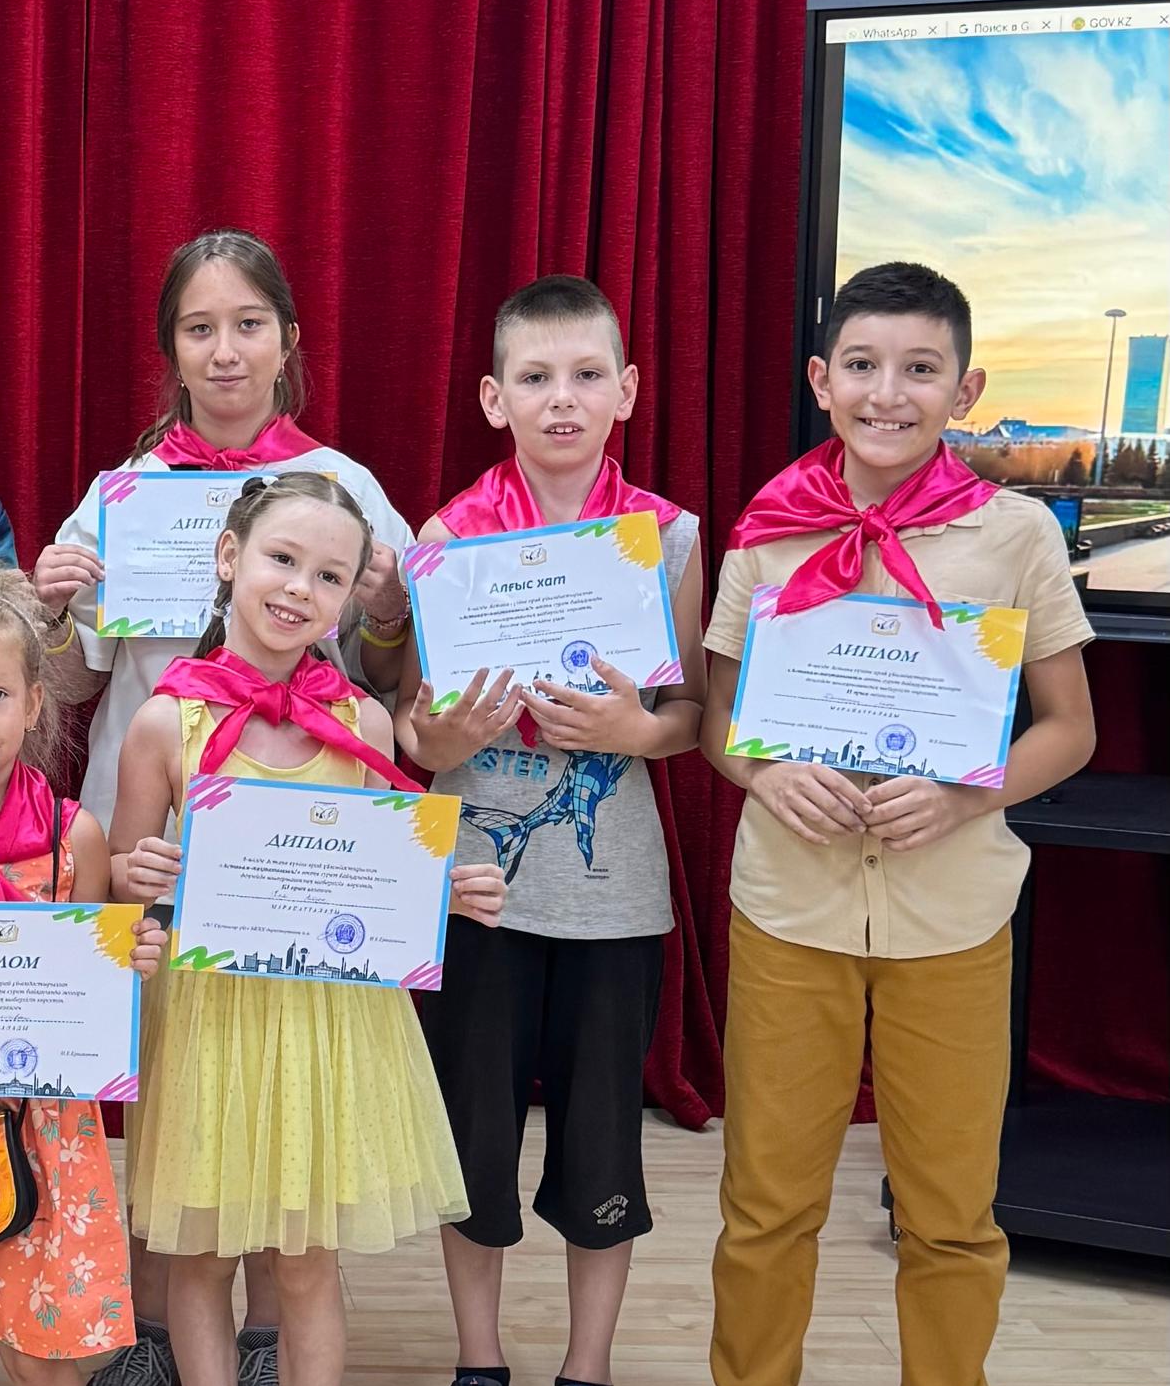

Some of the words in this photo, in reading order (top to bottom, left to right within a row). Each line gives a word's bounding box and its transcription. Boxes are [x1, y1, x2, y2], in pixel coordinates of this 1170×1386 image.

[863, 27, 918, 39] WhatsApp
[974, 23, 1009, 34] Поиск
[488, 577, 534, 596] Алғыс
[535, 573, 567, 590] хат
[826, 643, 920, 664] ДИПЛОМ
[264, 833, 357, 854] ДИПЛОМ
